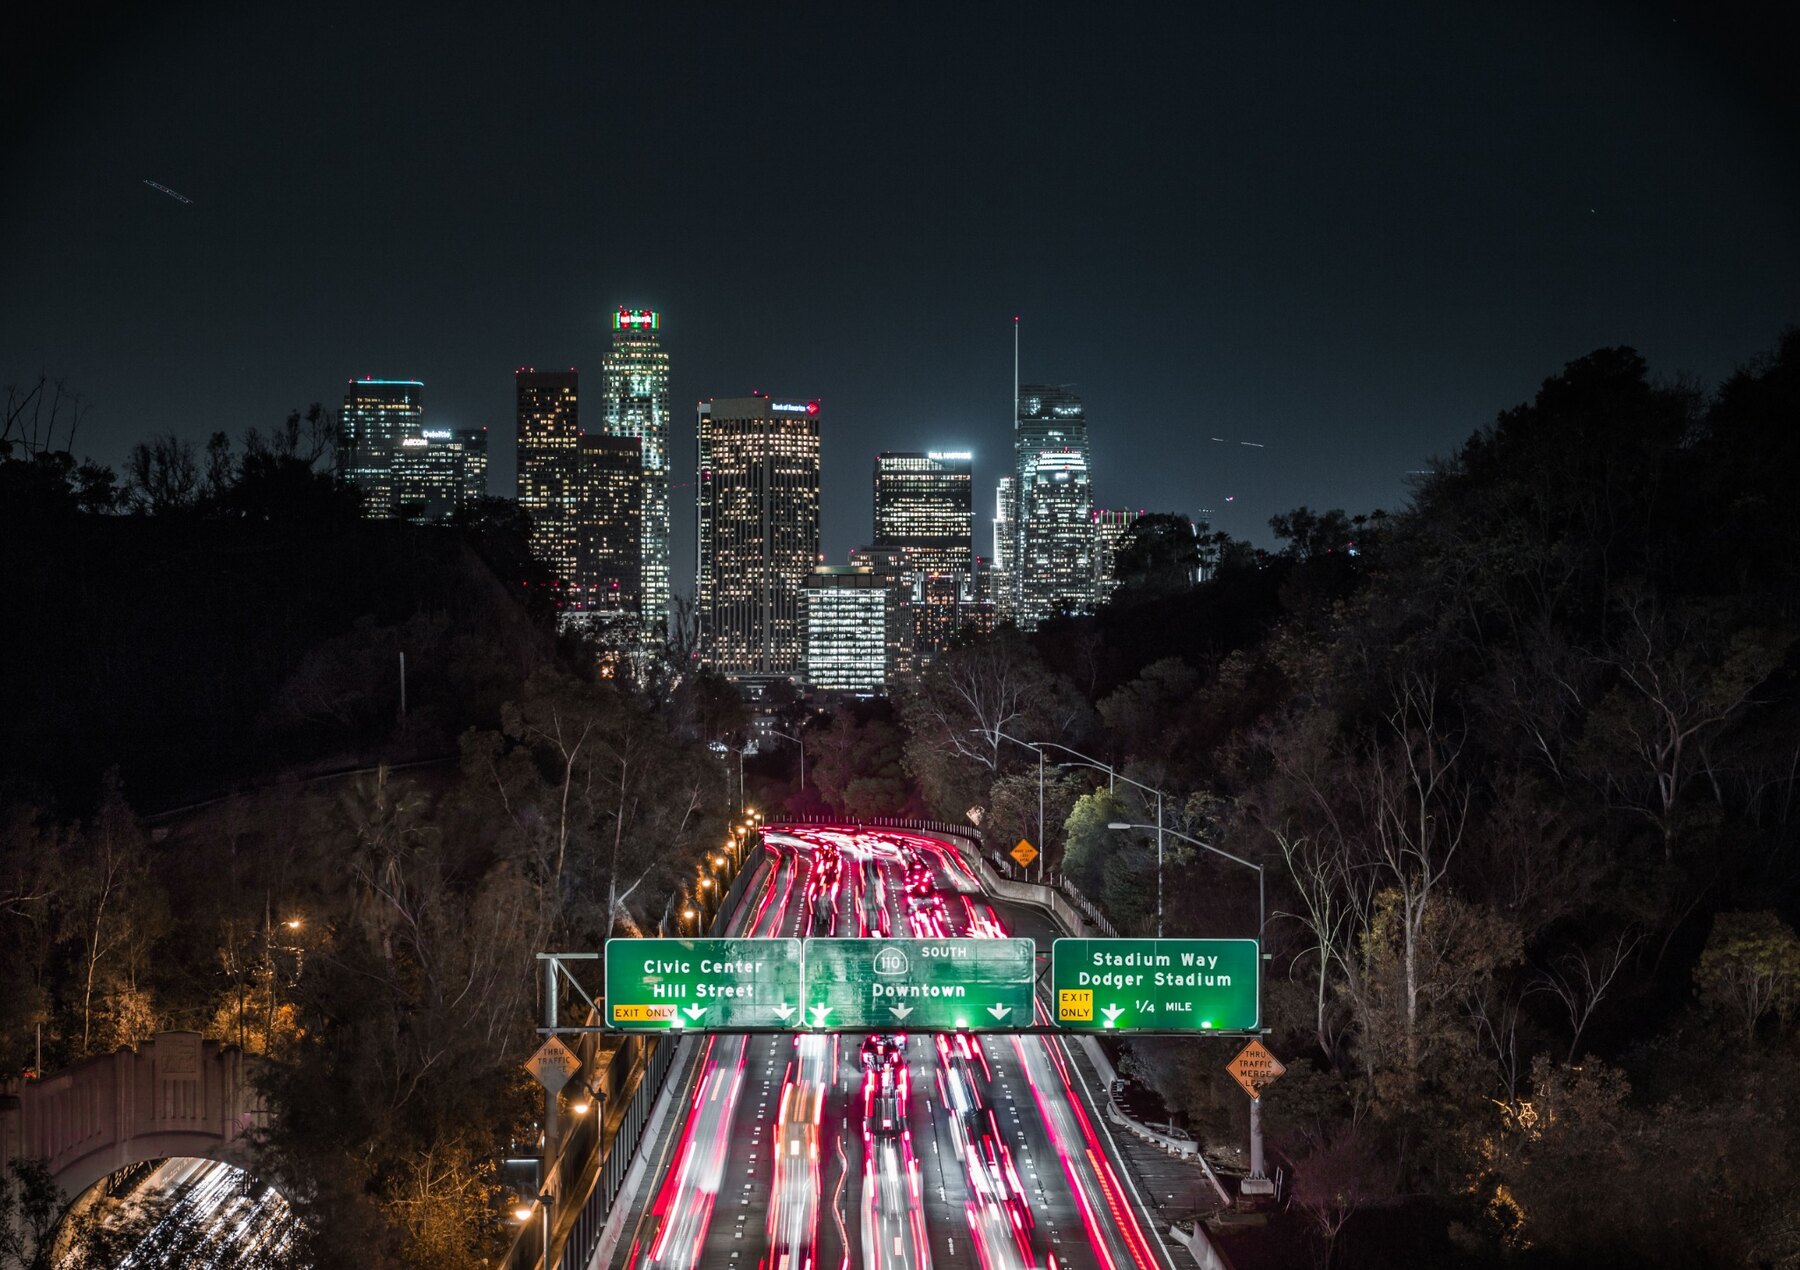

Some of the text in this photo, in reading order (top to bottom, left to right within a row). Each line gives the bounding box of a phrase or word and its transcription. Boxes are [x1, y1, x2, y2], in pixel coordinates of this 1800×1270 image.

[402, 438, 428, 446] AECOM
[921, 946, 967, 958] SOUTH
[881, 956, 900, 969] 110
[1093, 952, 1218, 969] Stadium Way
[643, 959, 763, 974] Civic Center
[1079, 972, 1231, 989] Dodger Stadium
[653, 983, 754, 998] Hill Street
[872, 983, 966, 998] Downtown
[1062, 993, 1090, 1002] EXIT
[1165, 1002, 1193, 1012] MILE
[615, 1008, 676, 1018] EXIT ONLY
[1061, 1008, 1090, 1018] ONLY
[544, 1048, 564, 1056] THRU
[1245, 1050, 1266, 1059] THRU
[538, 1056, 571, 1065] TRAFFIC
[1239, 1060, 1273, 1068] TRAFFIC
[1240, 1070, 1272, 1078] MERGE
